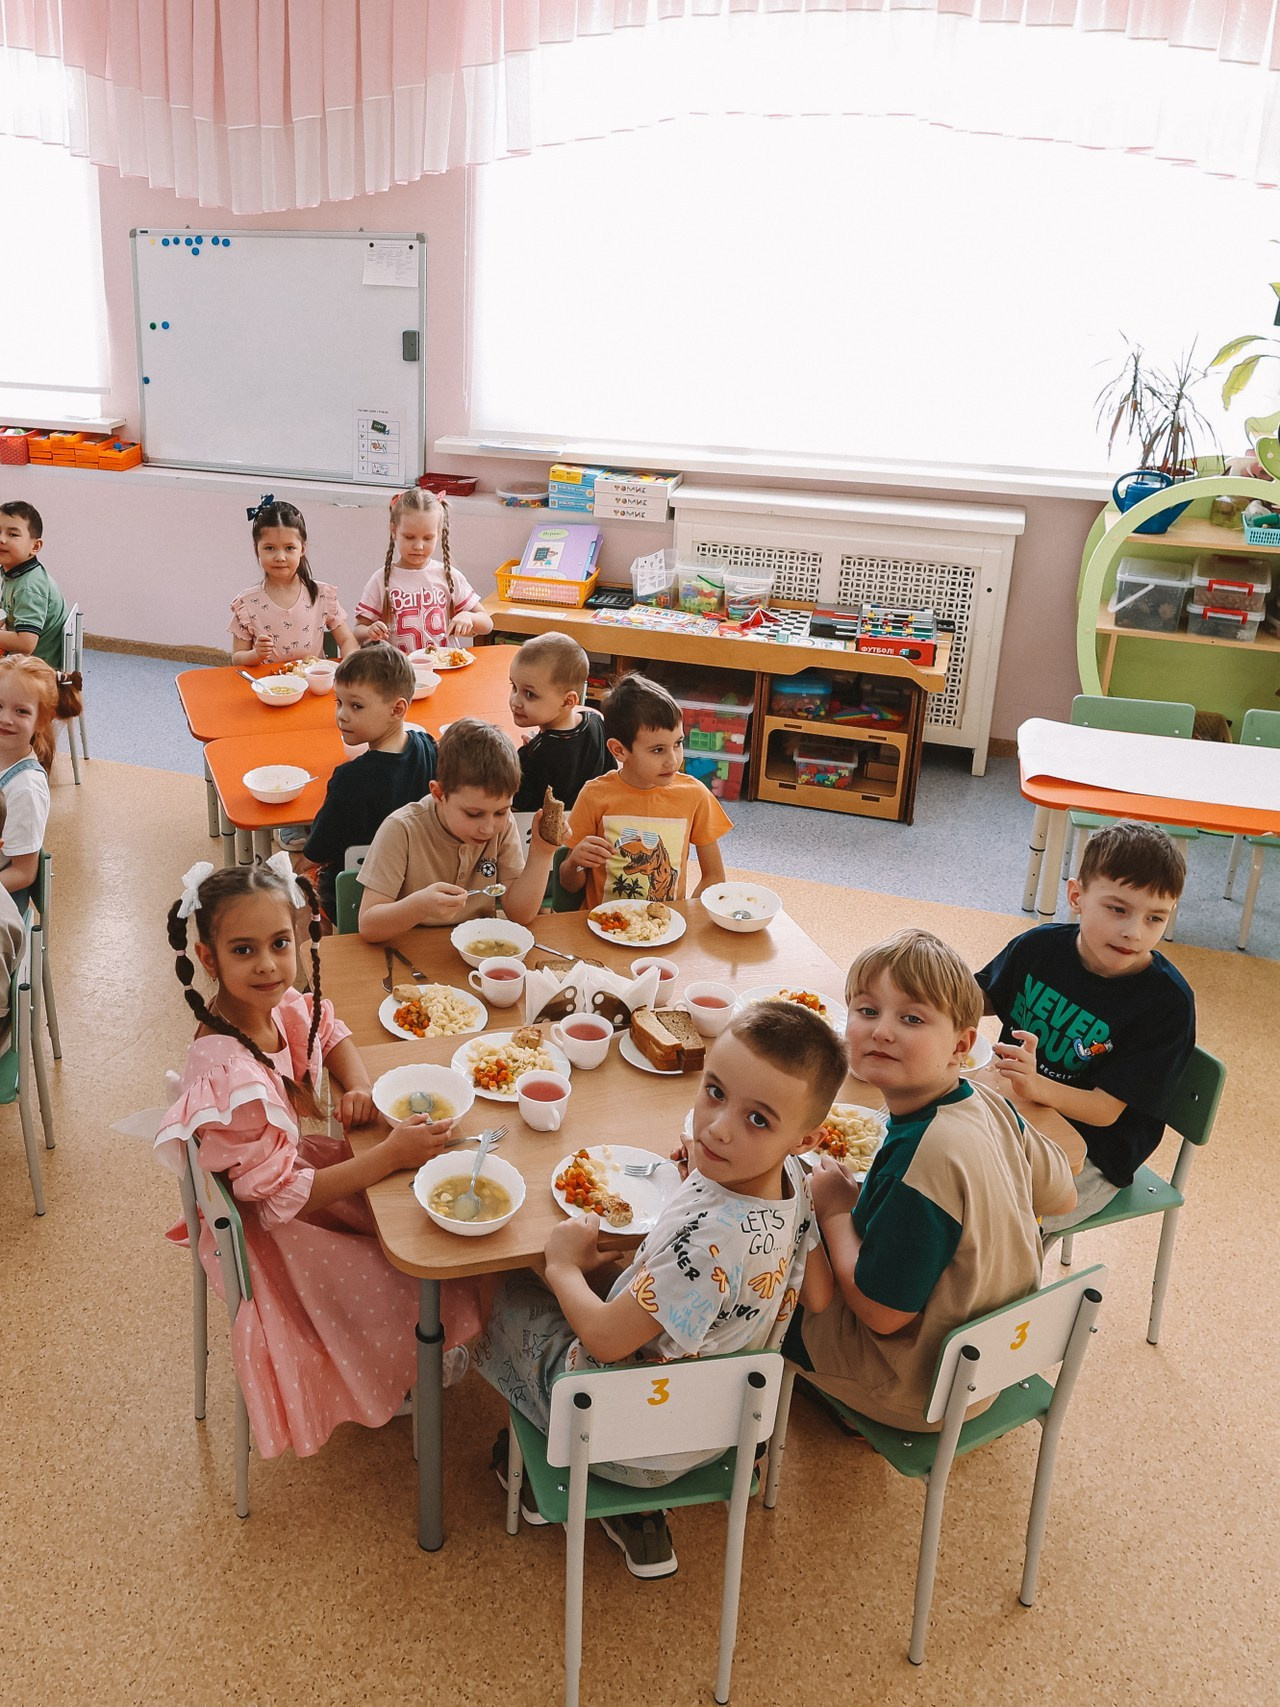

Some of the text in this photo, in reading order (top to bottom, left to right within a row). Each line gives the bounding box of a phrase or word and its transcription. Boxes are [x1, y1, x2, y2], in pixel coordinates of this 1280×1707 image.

[614, 484, 646, 494] ТОМИК
[614, 497, 648, 506] ТОМИК
[613, 509, 646, 518] ТОМИК
[390, 586, 446, 611] Barbie
[397, 607, 448, 653] 59
[860, 646, 895, 655] ФУТБОЛ!
[1024, 973, 1110, 1048] NEVER
[741, 1209, 785, 1234] LET'S
[1010, 1320, 1030, 1351] 3
[646, 1377, 670, 1406] 3
